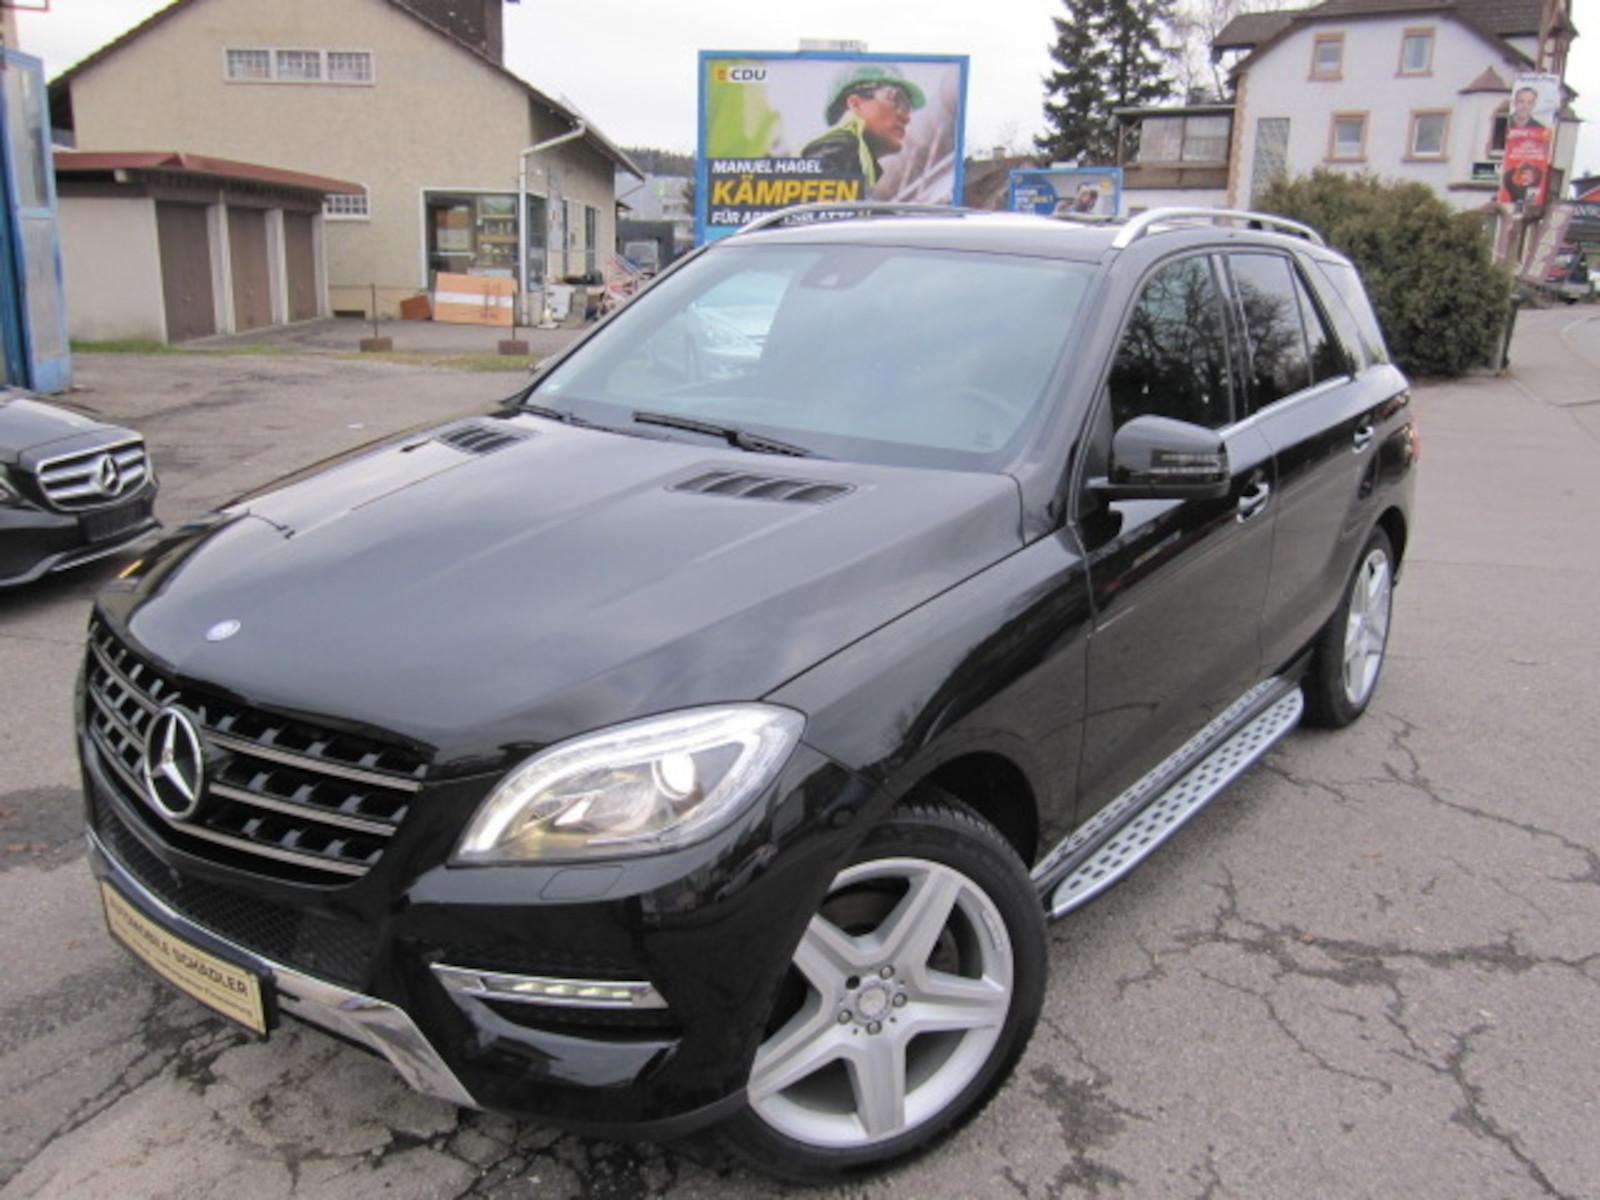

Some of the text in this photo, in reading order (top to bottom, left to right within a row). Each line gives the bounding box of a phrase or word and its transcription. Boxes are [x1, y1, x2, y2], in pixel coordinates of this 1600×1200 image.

[731, 69, 767, 81] CDU
[712, 160, 823, 174] MANUEL HAGEL
[712, 175, 859, 205] KÄMPFEN
[712, 209, 741, 224] FÜR
